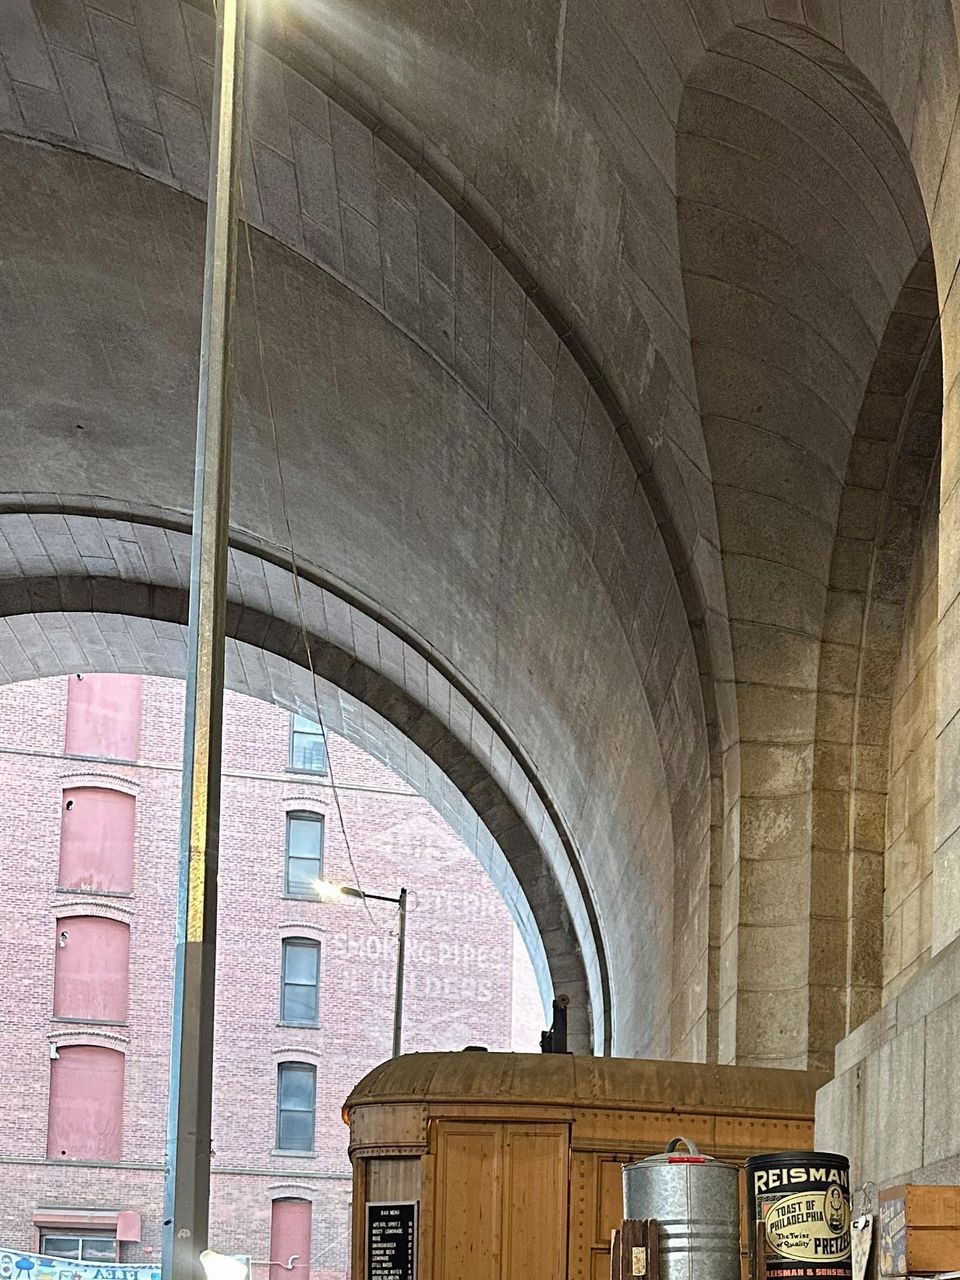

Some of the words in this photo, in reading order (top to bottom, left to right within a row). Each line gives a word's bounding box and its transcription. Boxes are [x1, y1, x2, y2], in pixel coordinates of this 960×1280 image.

[754, 1168, 848, 1195] REISMAN
[775, 1201, 803, 1218] TOAST
[805, 1200, 816, 1211] OF
[769, 1211, 825, 1234] PHILADELPHIA
